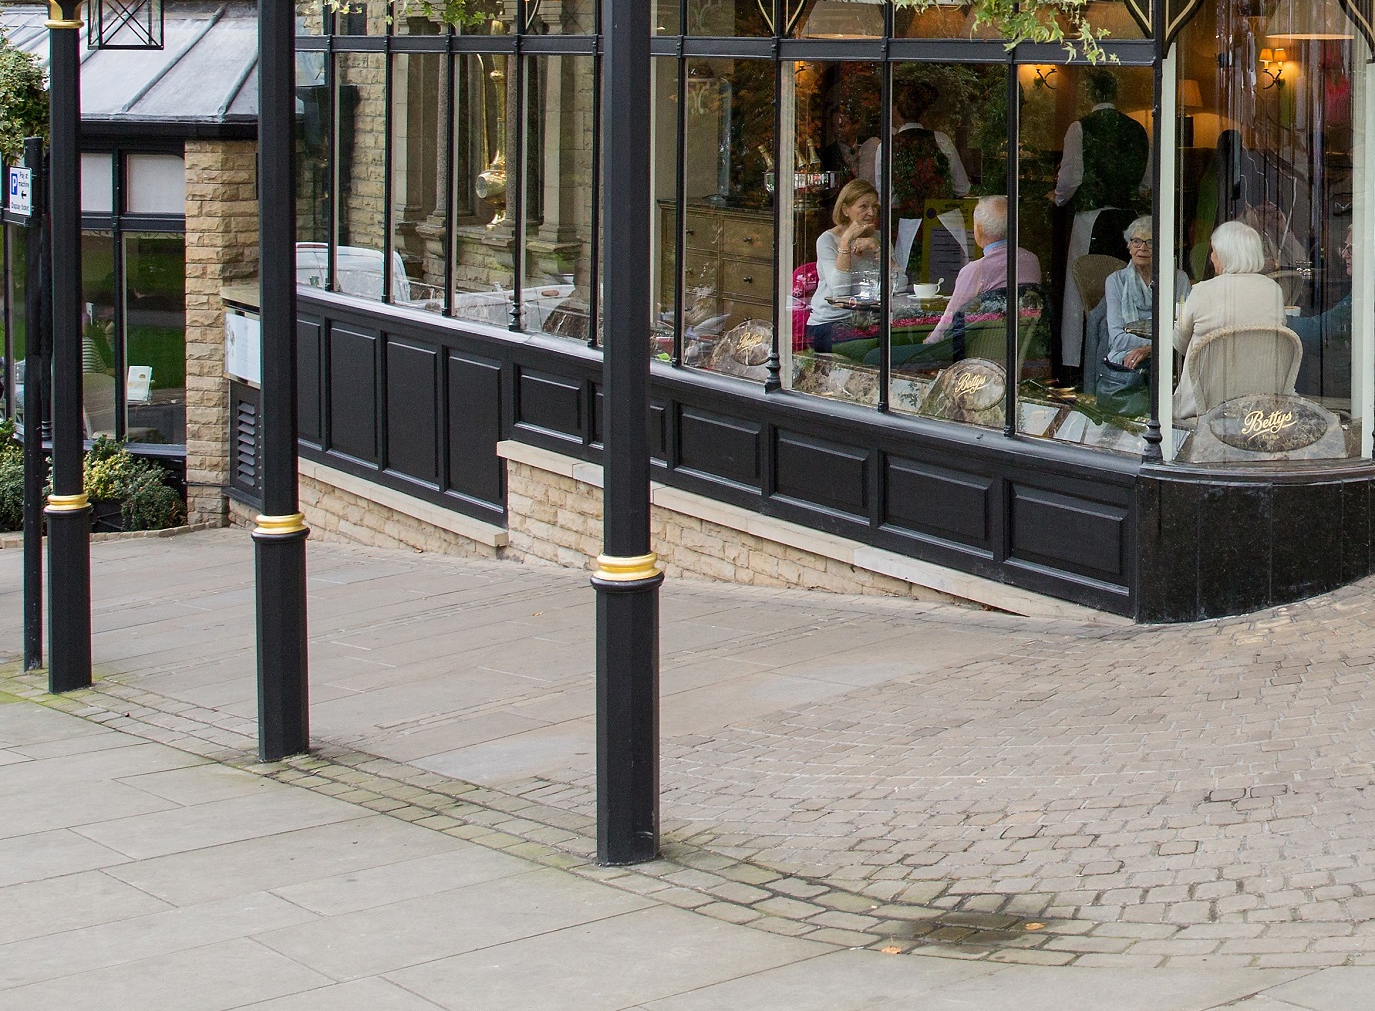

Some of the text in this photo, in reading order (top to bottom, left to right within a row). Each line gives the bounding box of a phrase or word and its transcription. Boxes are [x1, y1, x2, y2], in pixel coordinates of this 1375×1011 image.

[736, 332, 763, 354] Bettys
[955, 372, 988, 398] Bettys
[1241, 409, 1297, 441] Bettys
